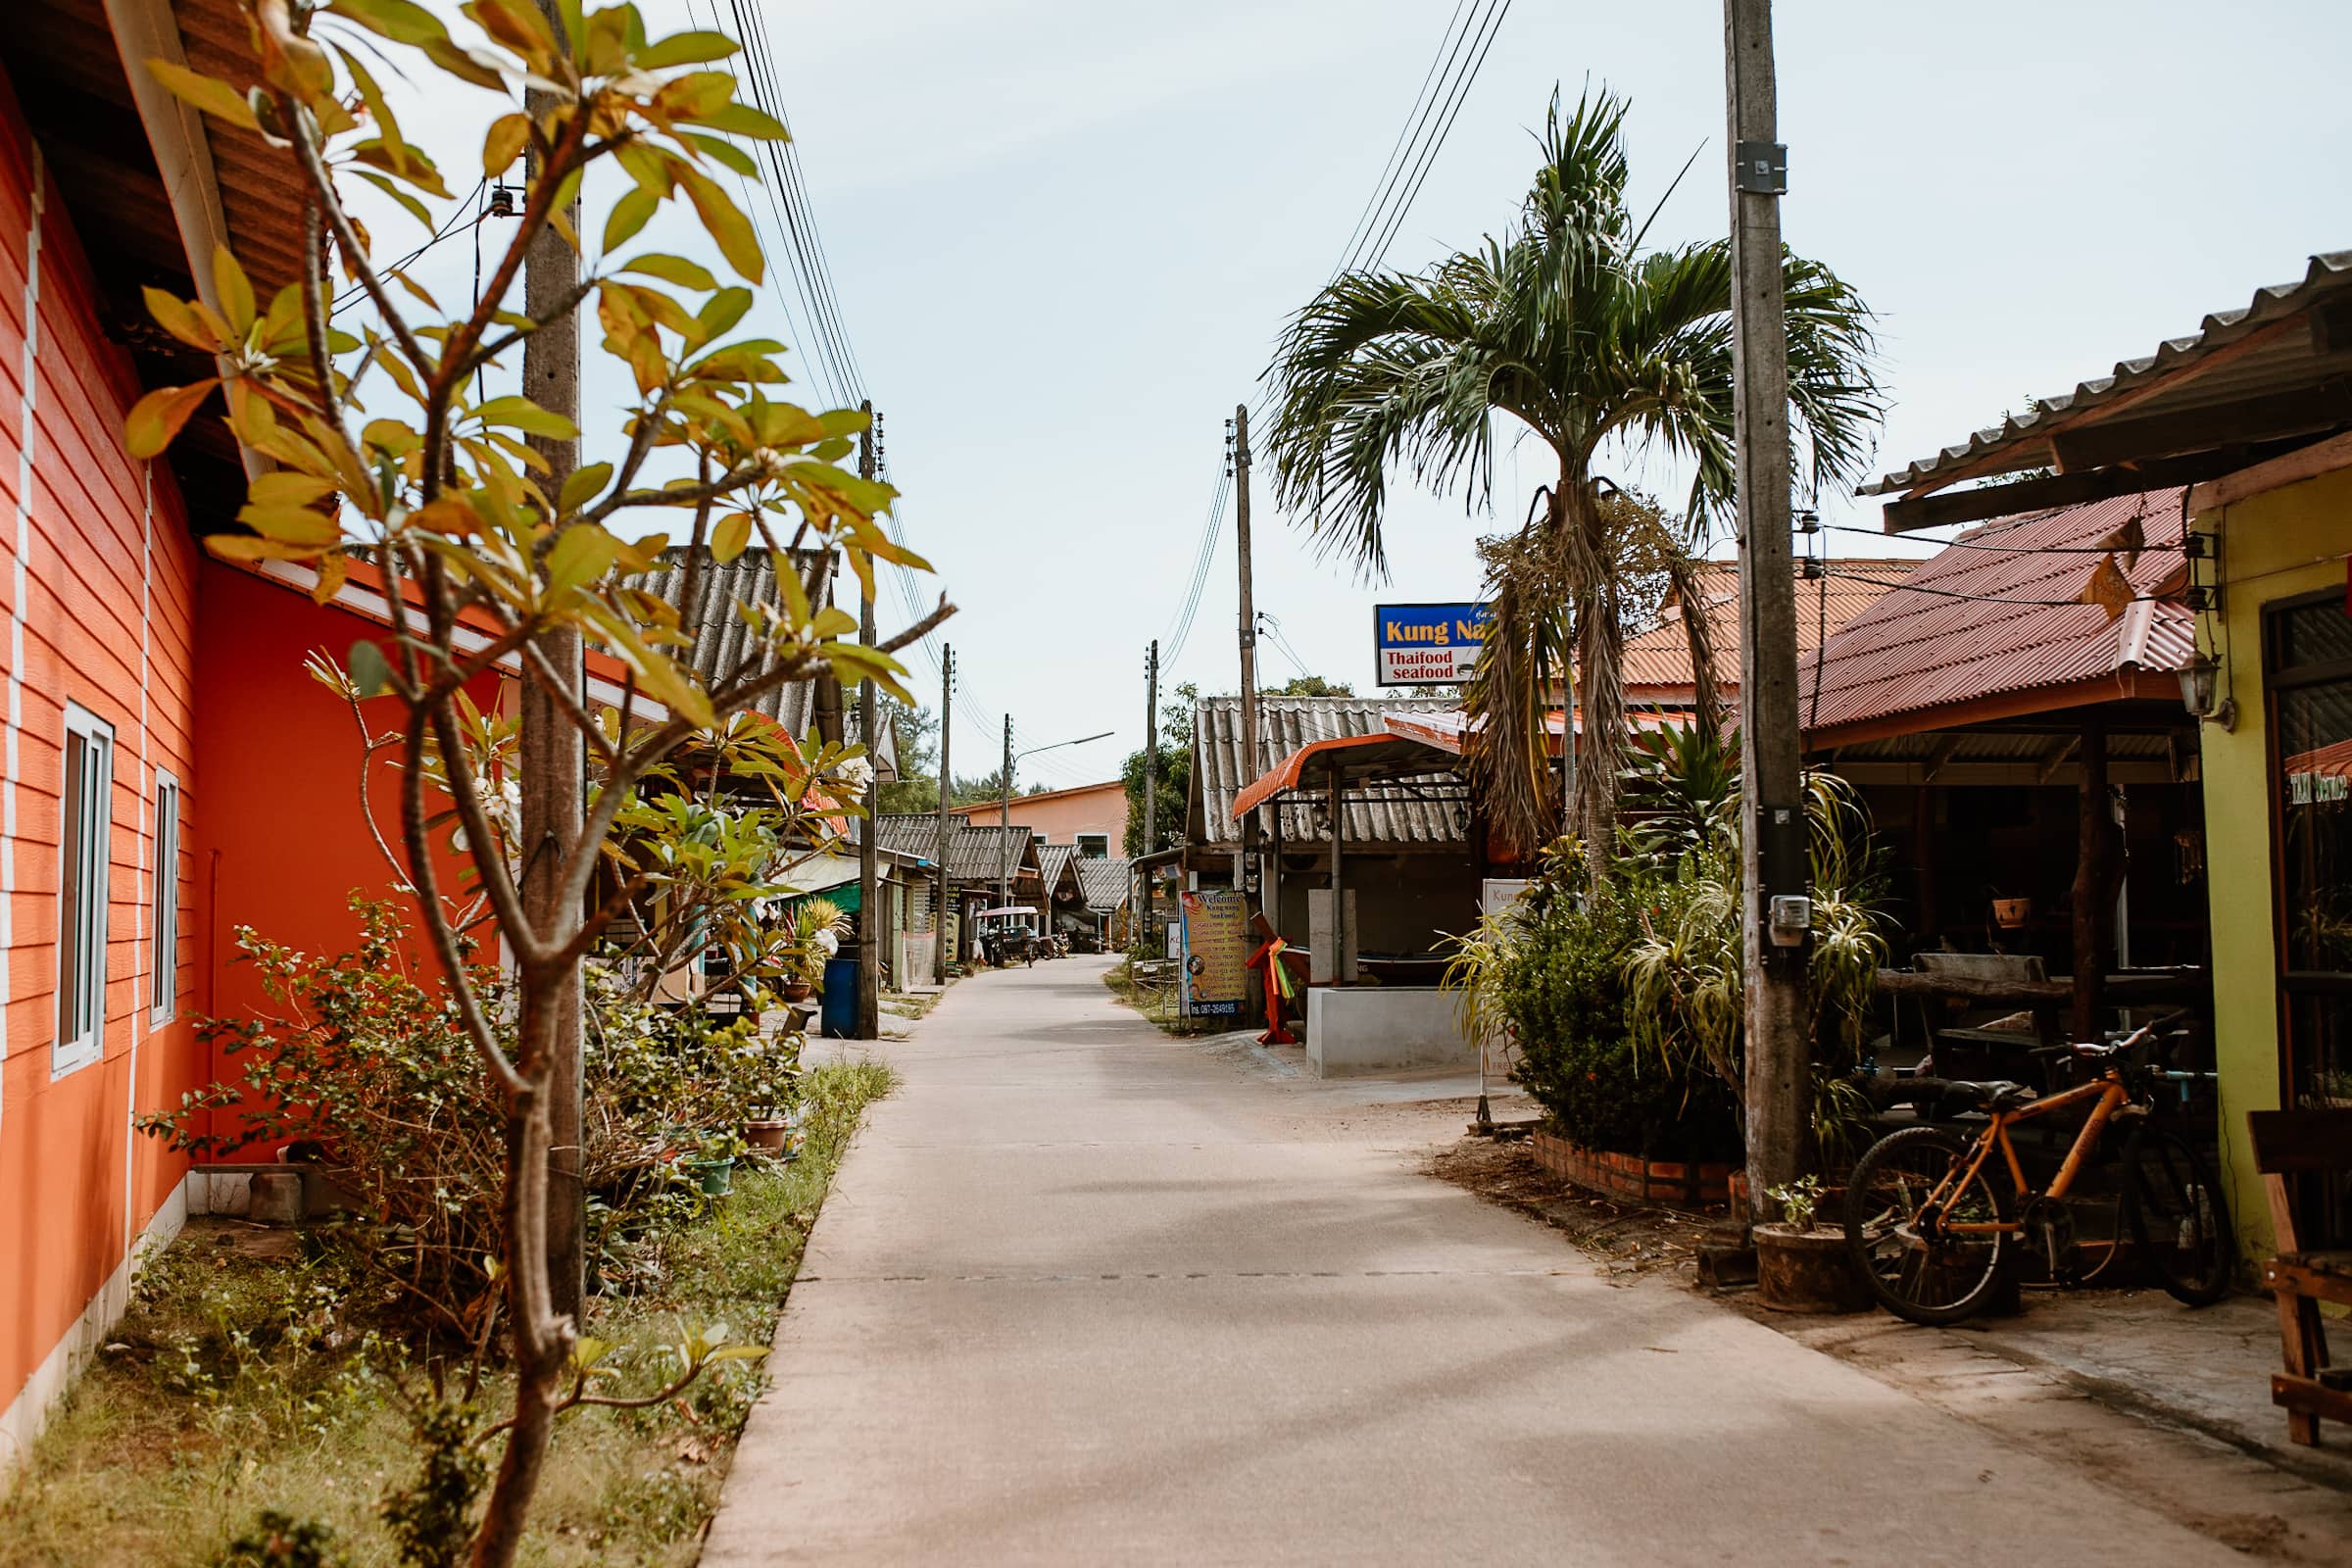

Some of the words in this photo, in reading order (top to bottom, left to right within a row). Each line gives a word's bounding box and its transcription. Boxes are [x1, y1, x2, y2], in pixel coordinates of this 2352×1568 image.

[1387, 620, 1449, 645] Kung
[1387, 651, 1452, 665] Thaifood
[1393, 664, 1453, 679] seafood
[2290, 772, 2312, 805] TAXI
[1198, 895, 1241, 904] Welcome
[1493, 889, 1516, 902] Kun
